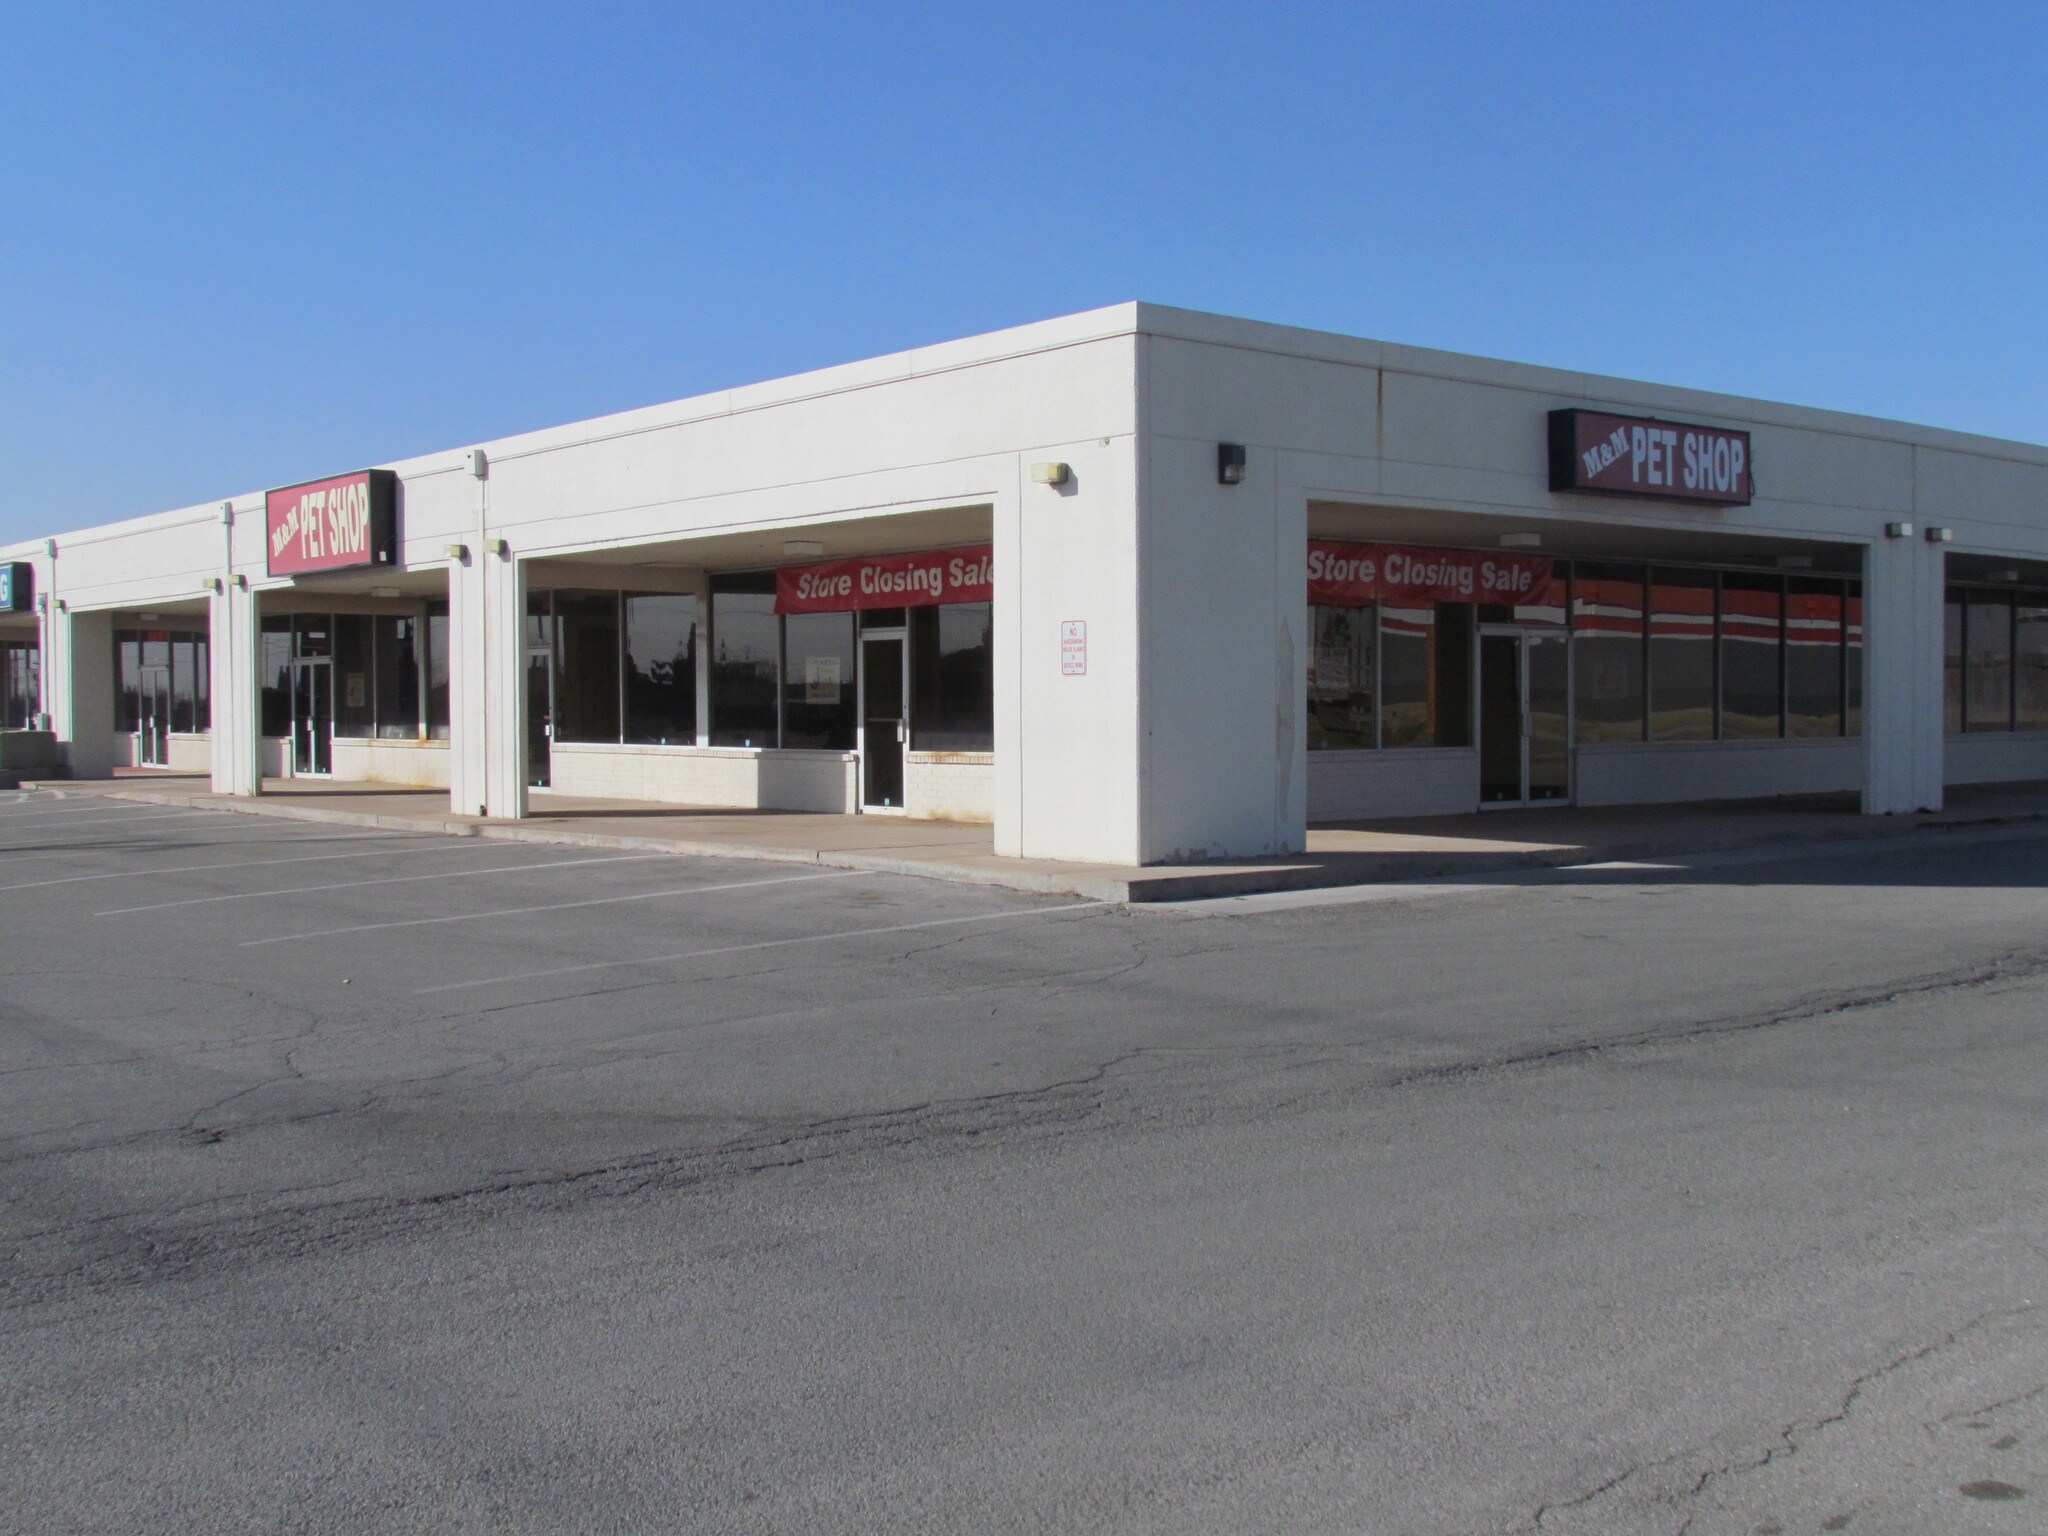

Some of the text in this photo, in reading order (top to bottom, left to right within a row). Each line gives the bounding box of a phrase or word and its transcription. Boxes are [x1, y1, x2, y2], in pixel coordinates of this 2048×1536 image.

[1582, 426, 1744, 493] M&M PET SHOP
[272, 482, 369, 559] M&M PET SHOP
[796, 556, 994, 600] Store Closing Sal
[1307, 550, 1532, 594] Store Closing Sale
